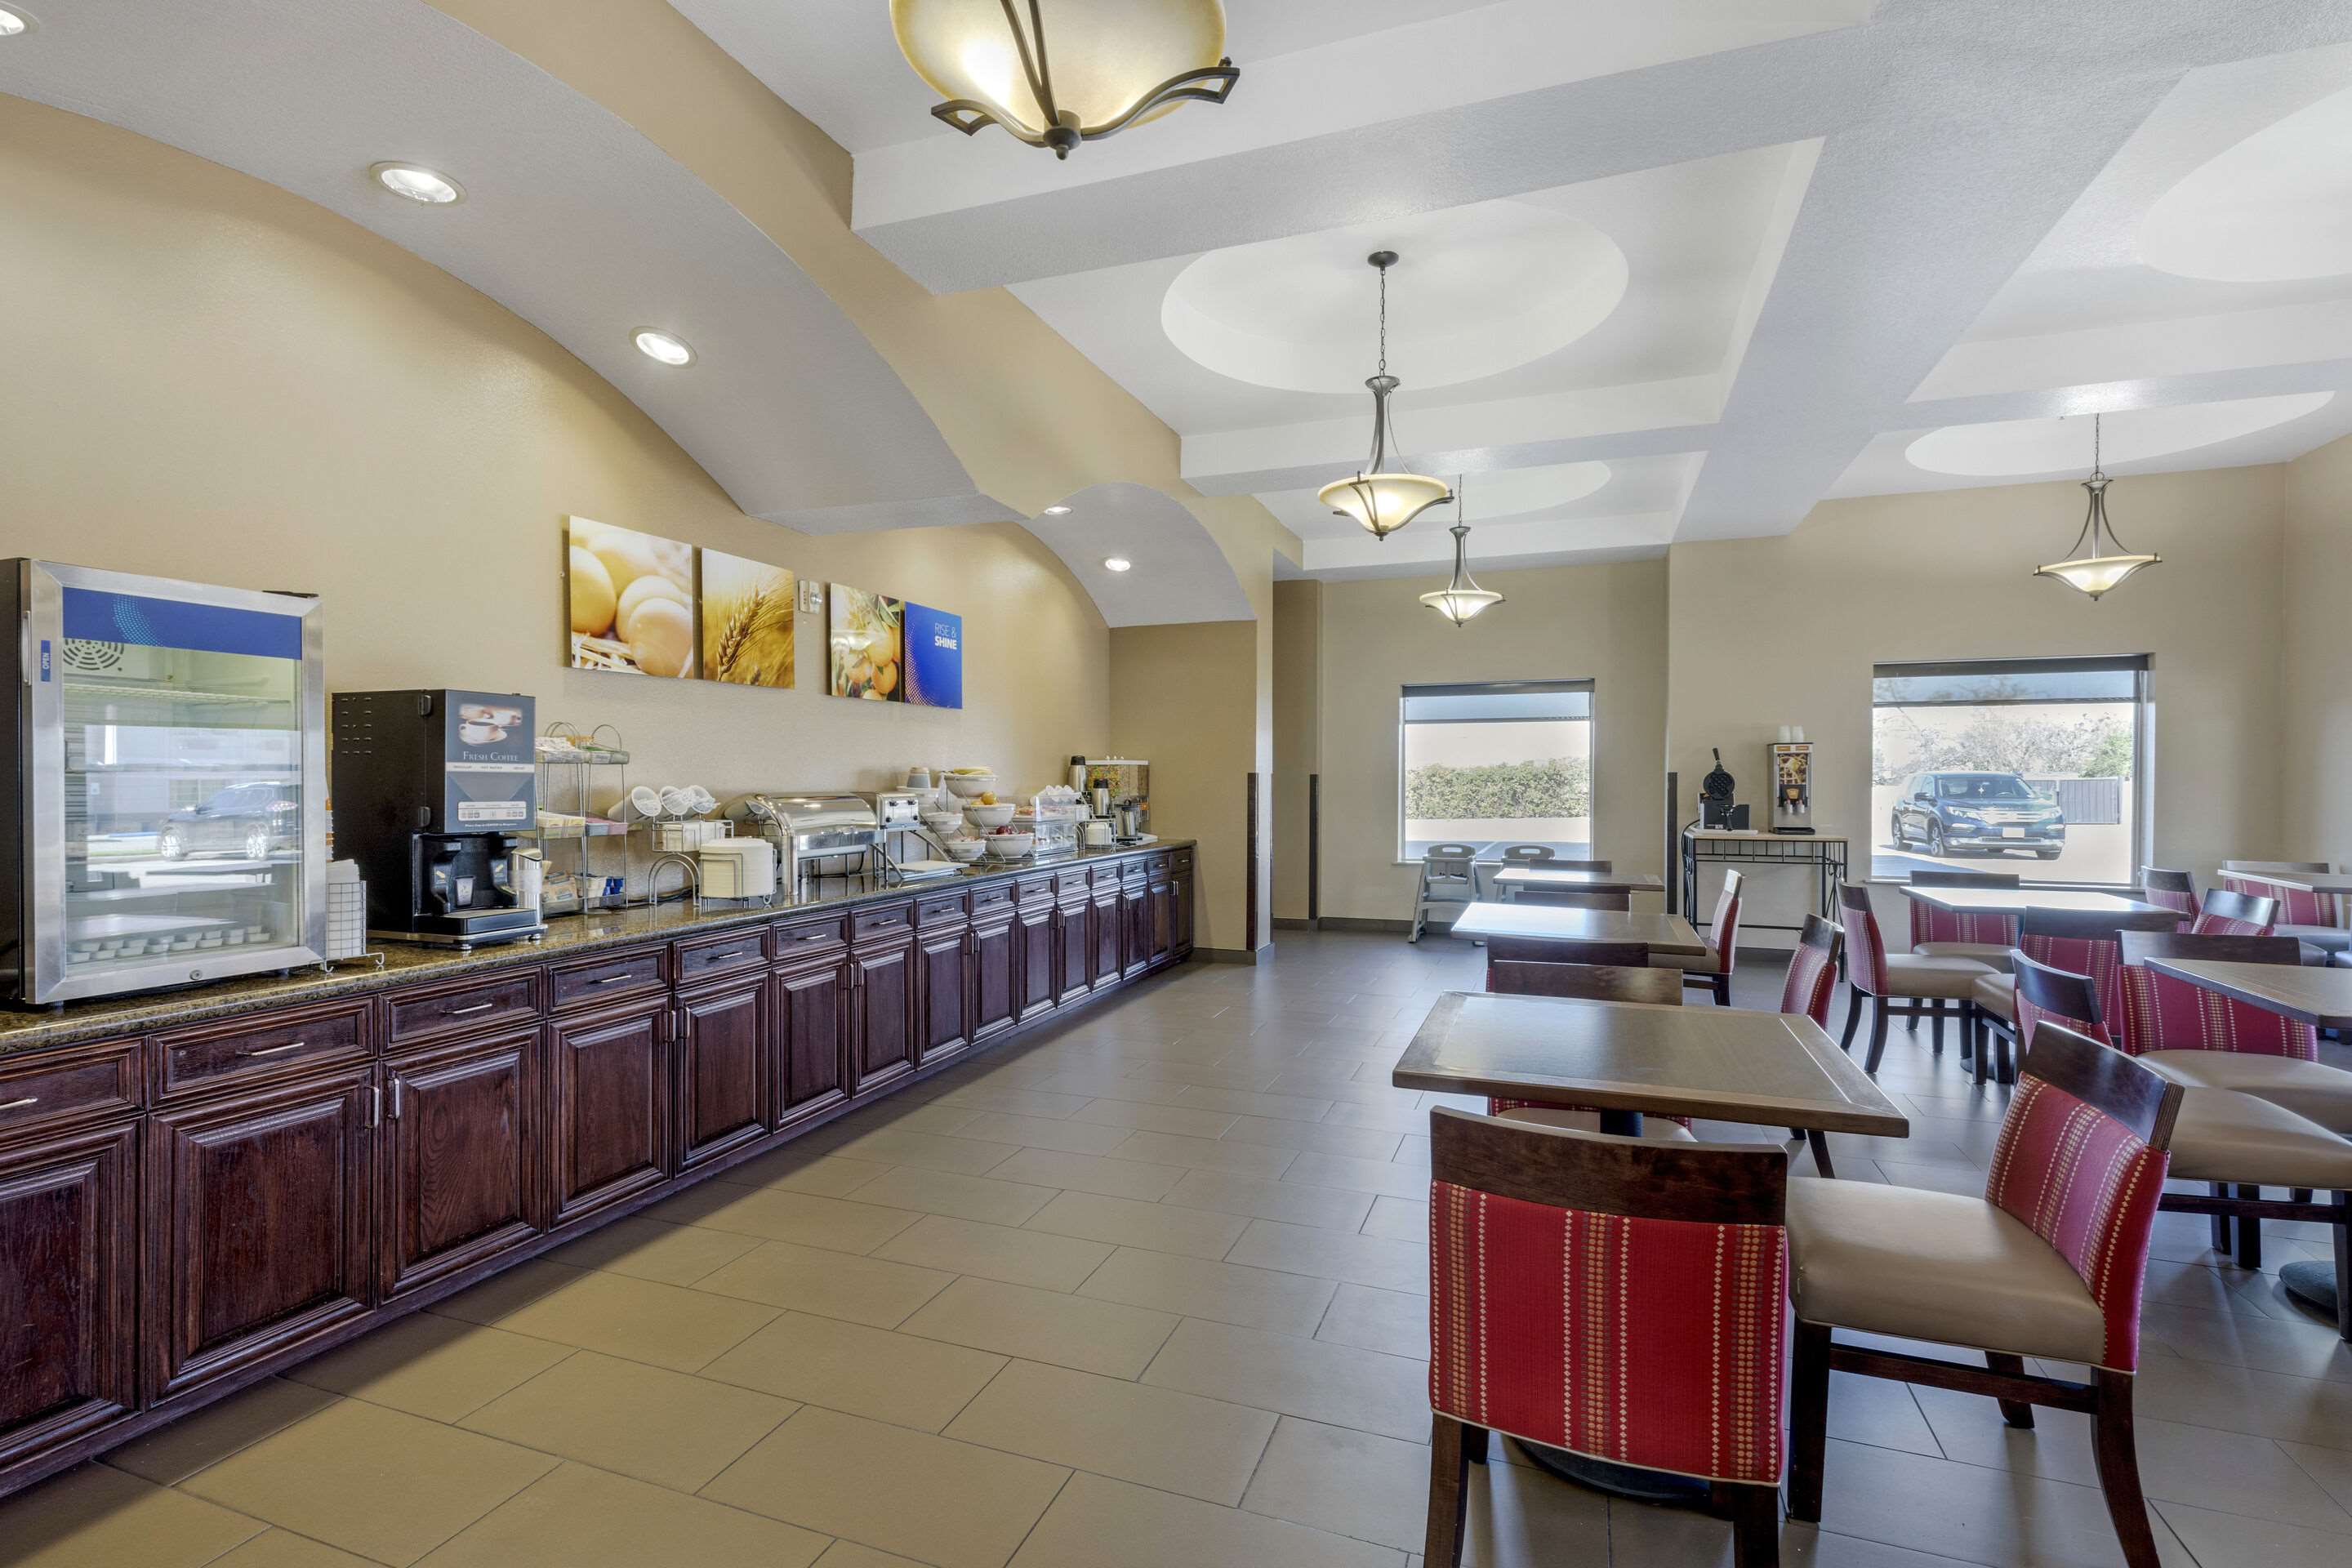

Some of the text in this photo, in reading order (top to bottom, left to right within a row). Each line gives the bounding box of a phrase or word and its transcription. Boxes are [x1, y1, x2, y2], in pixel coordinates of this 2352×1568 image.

[934, 622, 956, 639] RISE &
[934, 635, 958, 650] SHINE
[42, 653, 50, 670] OPEN
